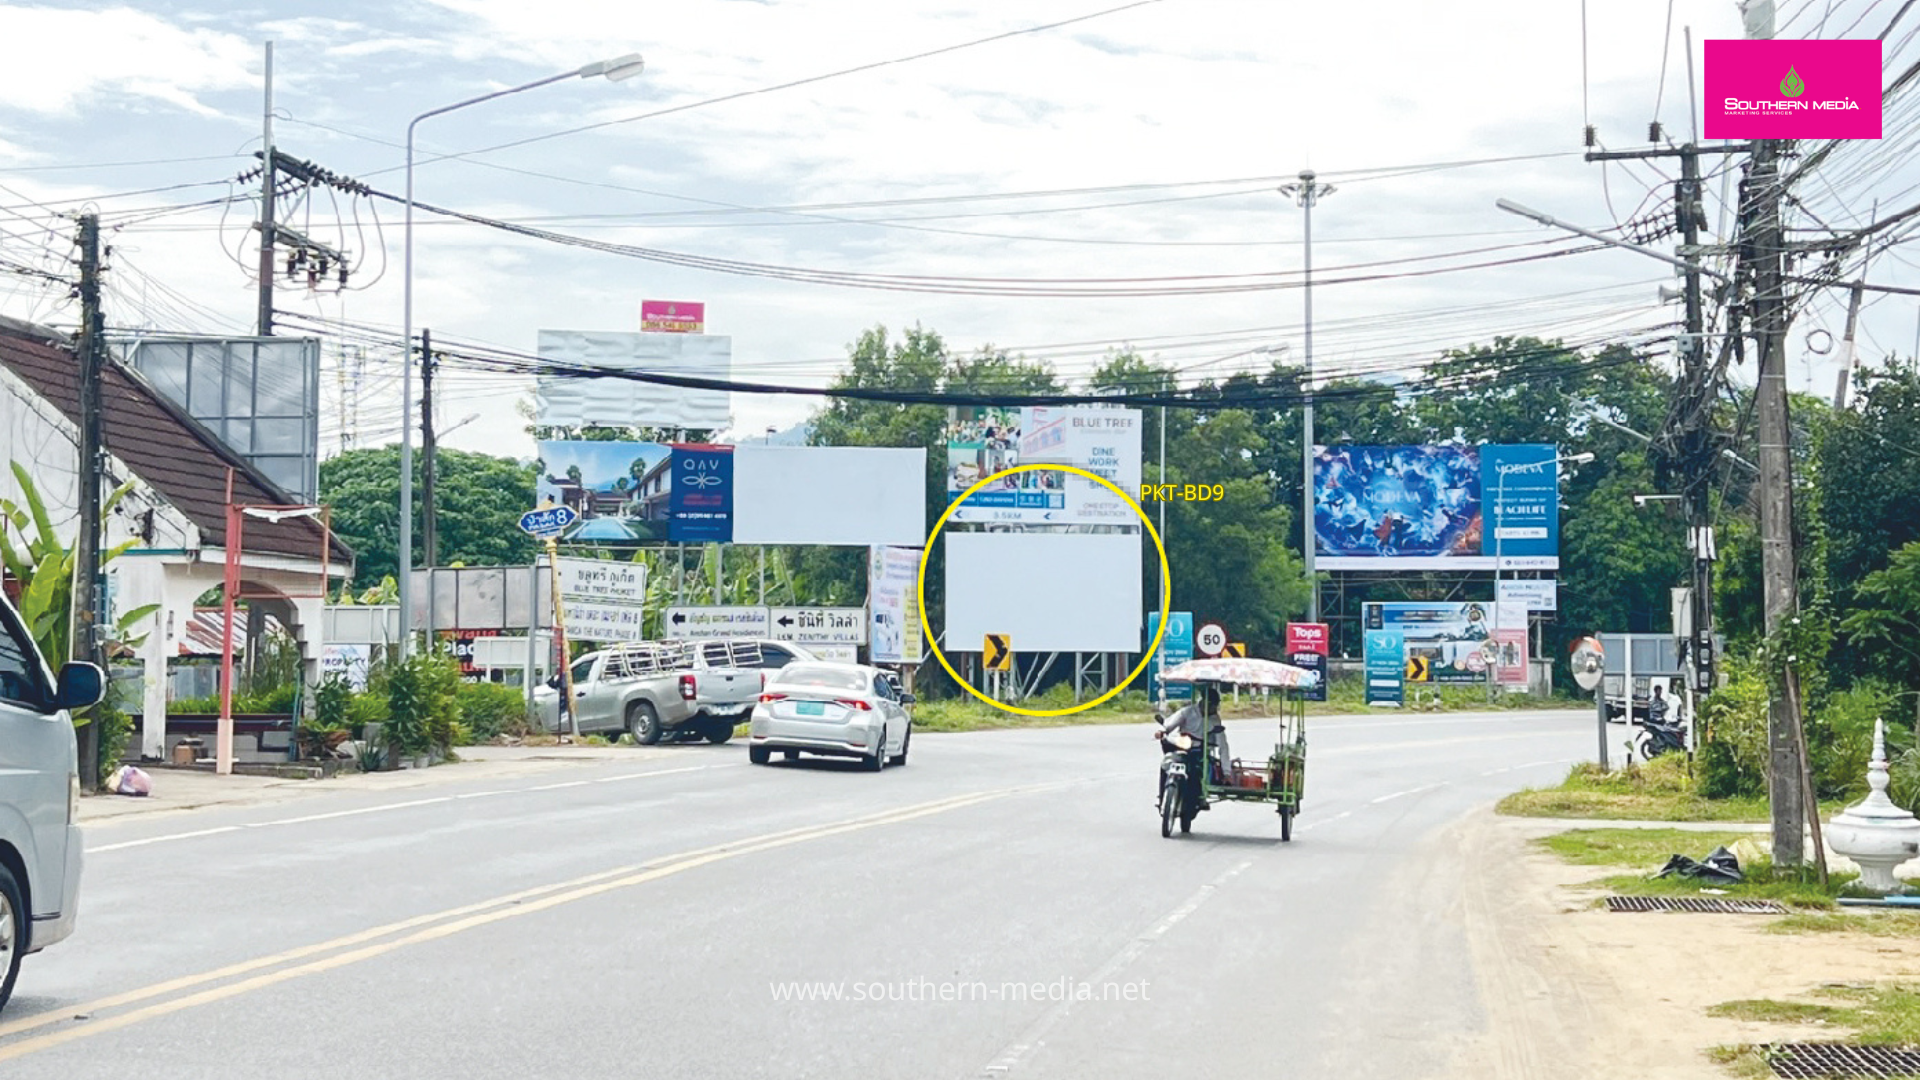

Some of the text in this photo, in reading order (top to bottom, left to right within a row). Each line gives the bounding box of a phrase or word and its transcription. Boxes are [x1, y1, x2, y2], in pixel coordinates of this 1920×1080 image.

[1072, 417, 1133, 428] BLUE TREE
[1092, 446, 1116, 457] DINE
[1087, 457, 1119, 467] WORK
[556, 509, 568, 524] 8
[1294, 627, 1322, 640] Tops
[1203, 634, 1221, 646] 50
[1372, 634, 1397, 650] SO
